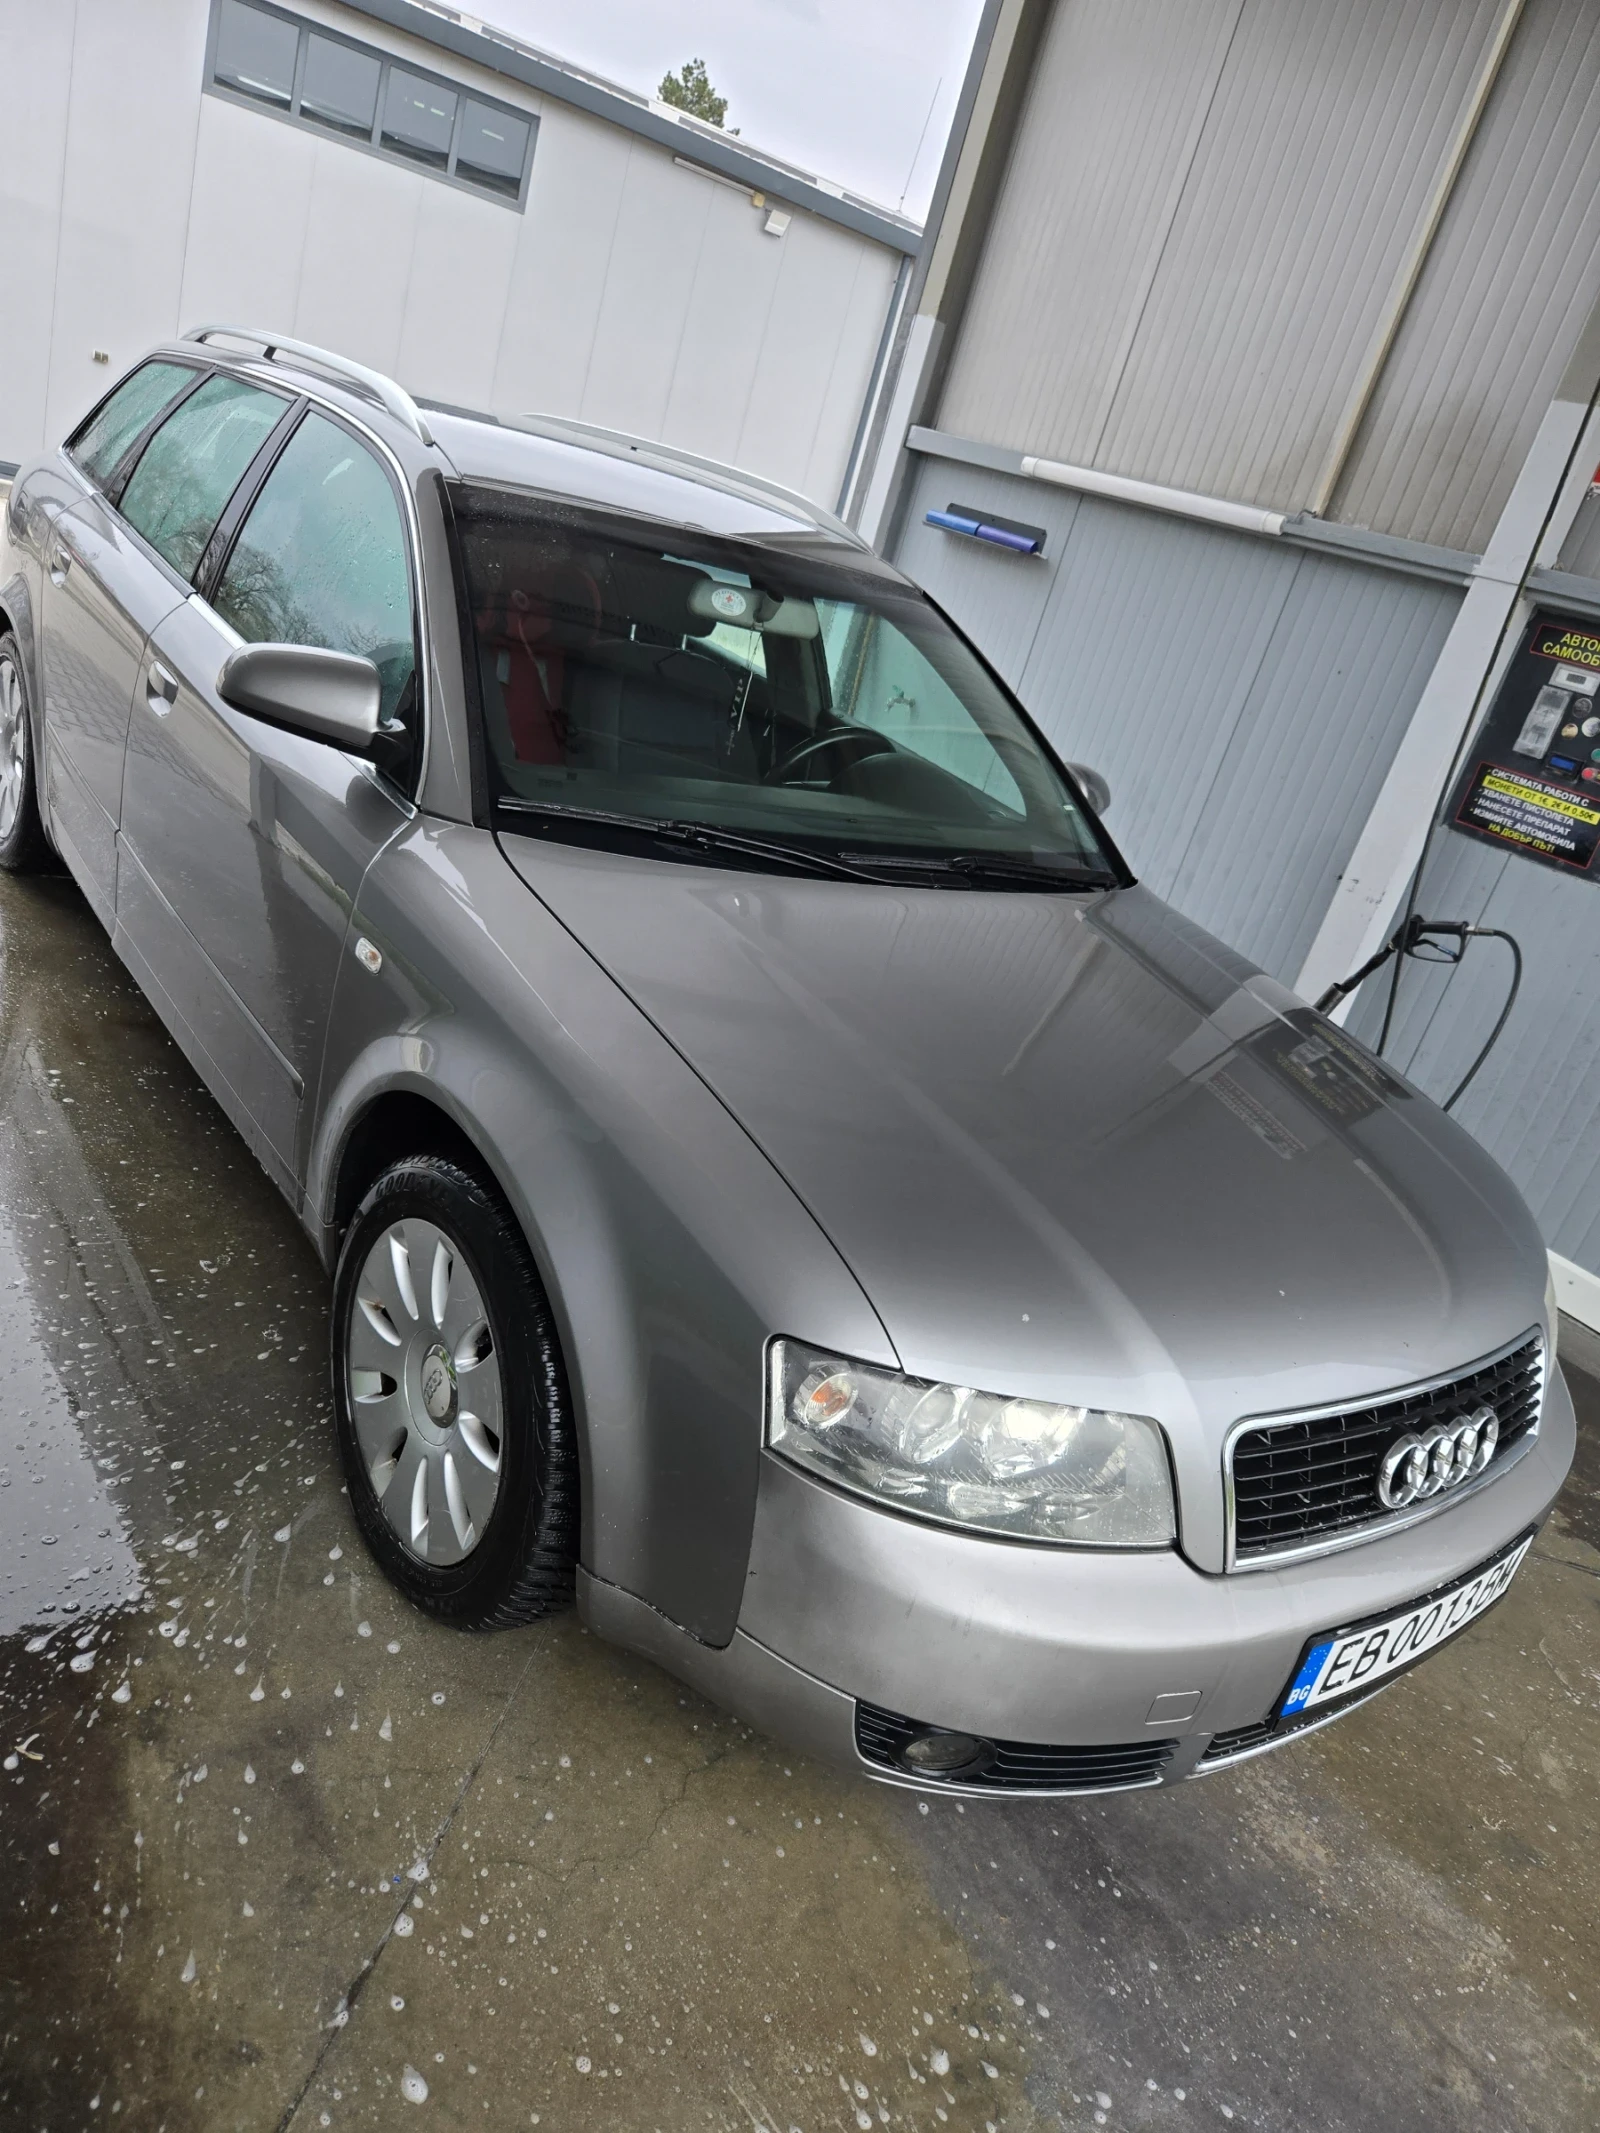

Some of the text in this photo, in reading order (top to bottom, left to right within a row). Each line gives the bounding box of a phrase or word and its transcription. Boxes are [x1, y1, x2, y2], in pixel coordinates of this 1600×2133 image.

[1486, 778, 1523, 797] МОНЕТИ
[1523, 791, 1538, 801] ОТ
[1491, 768, 1542, 791] СИСТЕМАТА
[1543, 786, 1580, 804] РАБОТИ
[1477, 797, 1572, 836] НАНЕСЕТЕ ПРЕПАРАТ
[1481, 789, 1574, 827] ХВАНЕТЕ ПИСТОЛЕТА
[1487, 823, 1501, 833] НА
[1500, 827, 1532, 843] ДОБЪР
[1512, 822, 1576, 851] АВТОМОБИЛА
[1317, 1628, 1390, 1696] EB
[1286, 1684, 1311, 1706] BG
